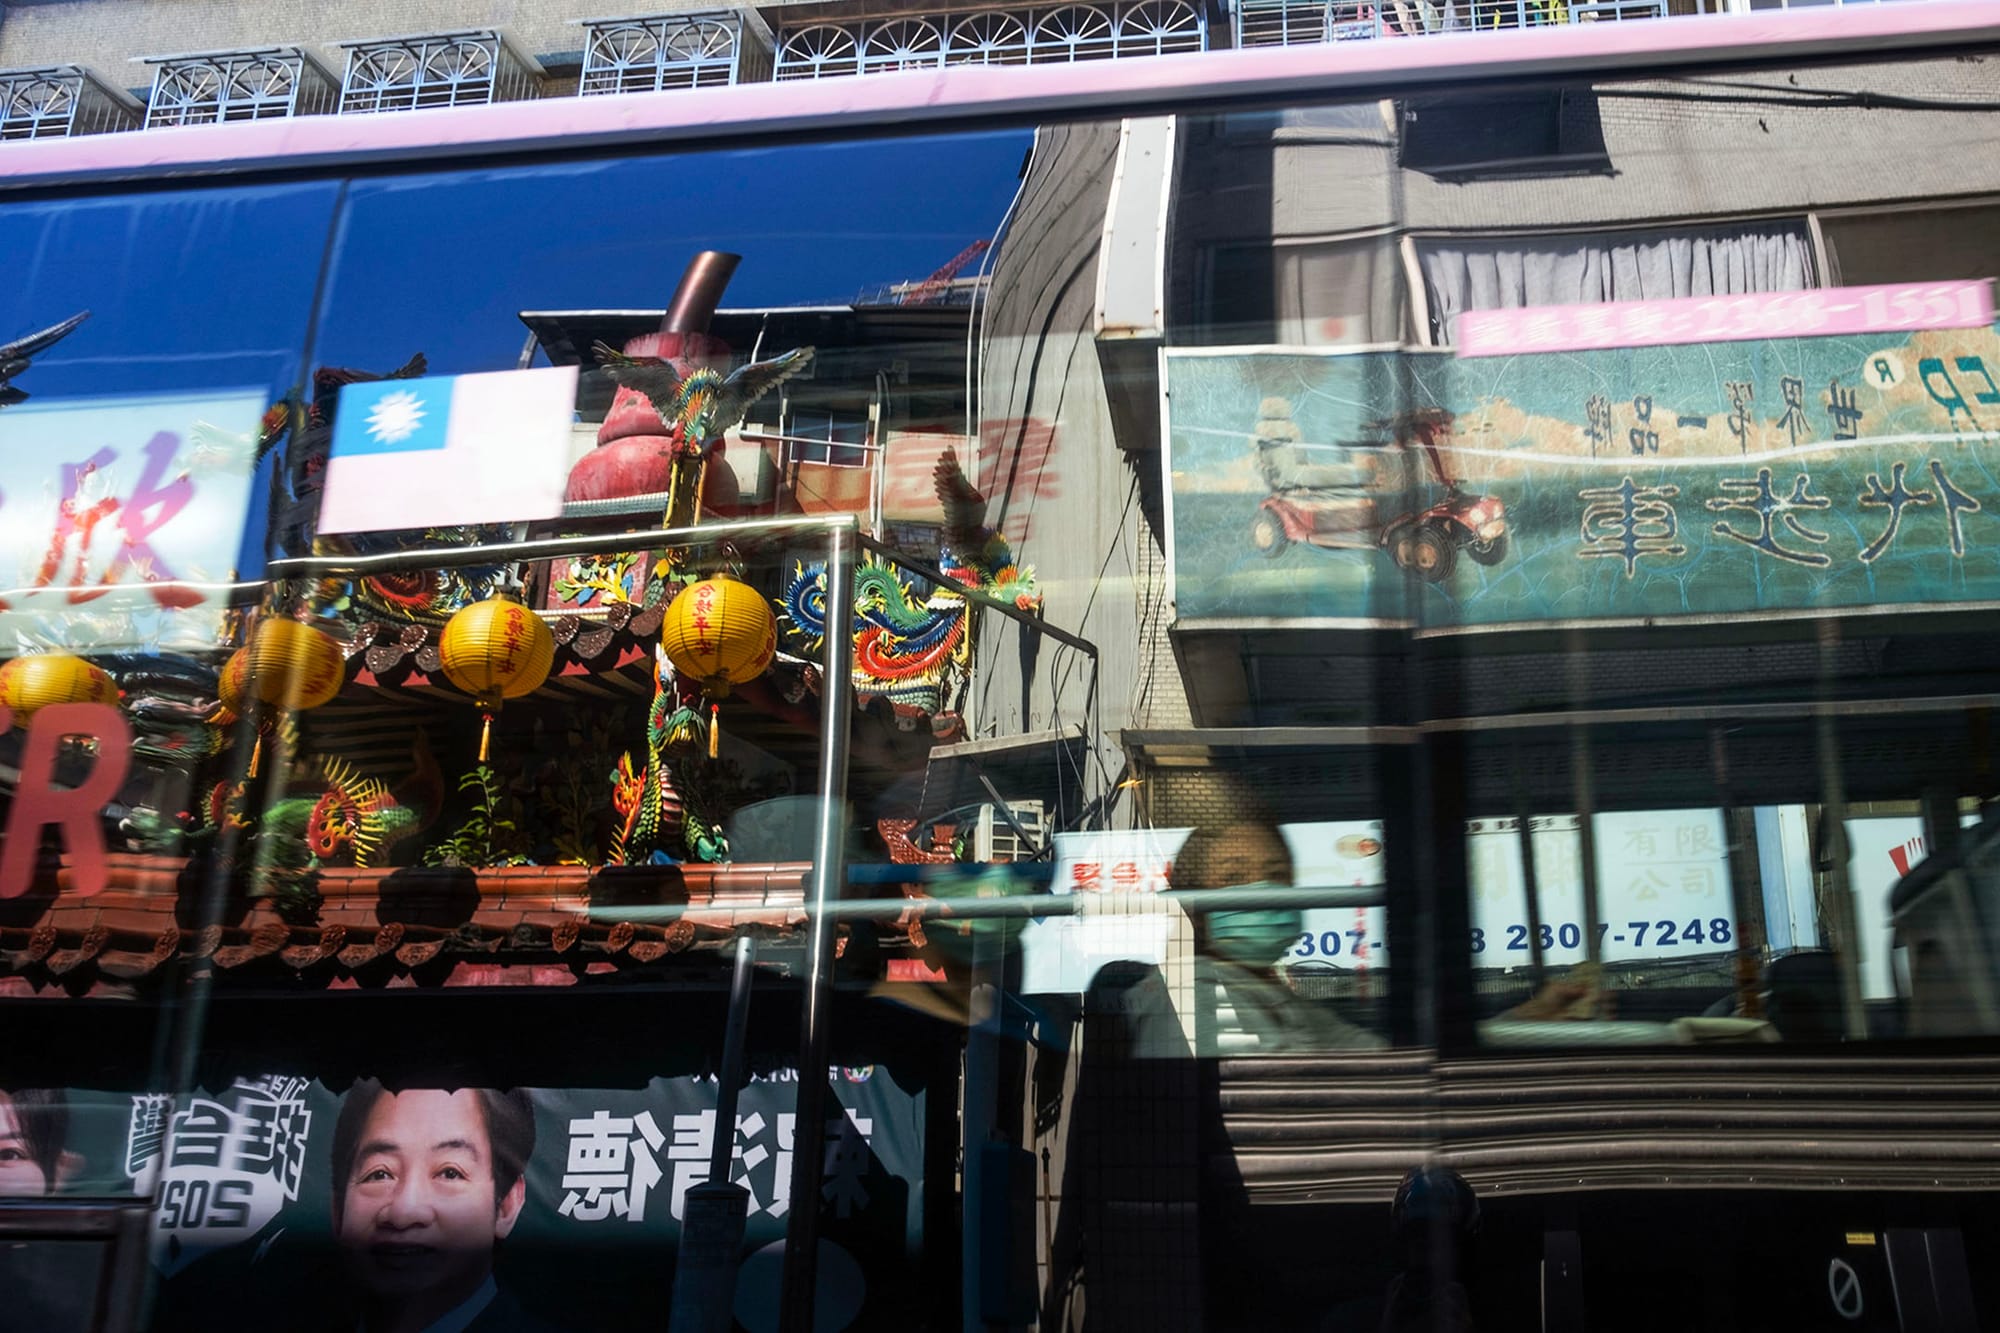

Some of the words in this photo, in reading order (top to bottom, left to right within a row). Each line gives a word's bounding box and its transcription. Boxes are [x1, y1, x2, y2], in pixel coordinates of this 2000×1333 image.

[0, 430, 208, 609] 欣
[0, 703, 131, 897] R
[1506, 917, 1732, 950] 2307-7248
[1627, 867, 1717, 902] 公司
